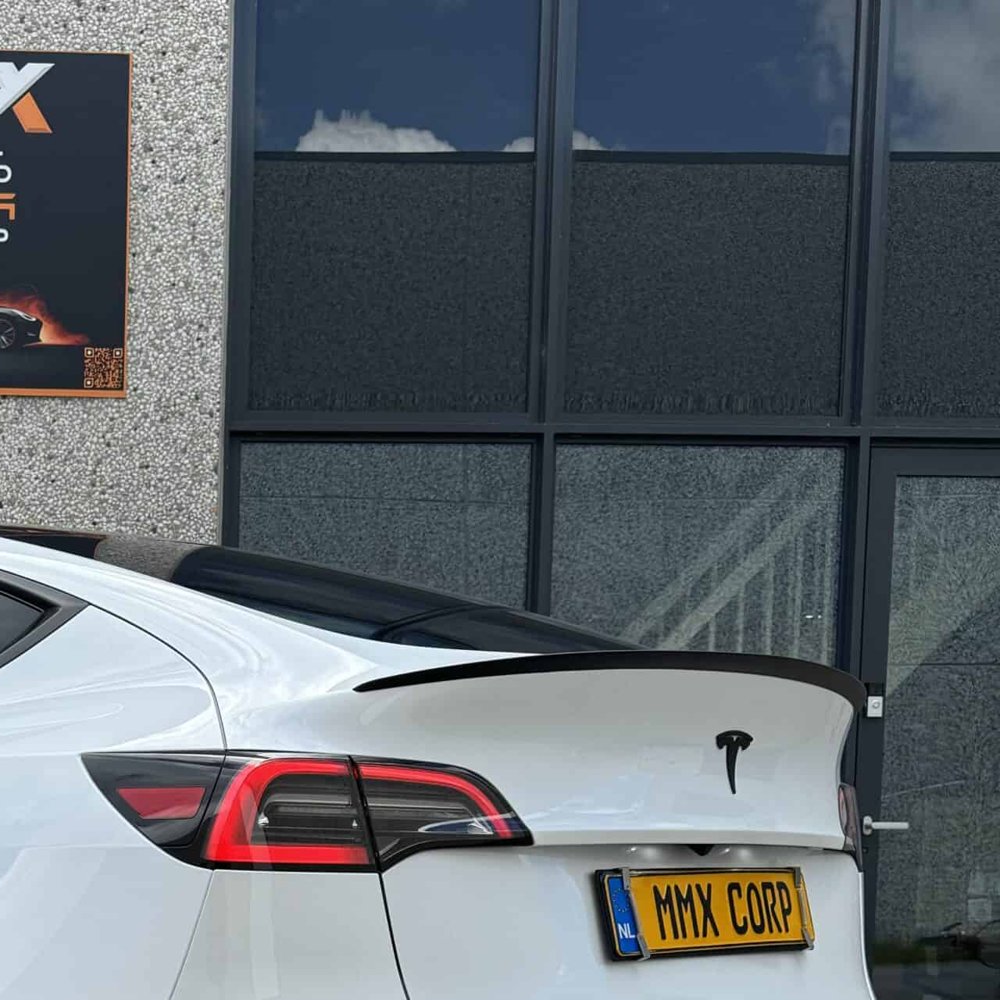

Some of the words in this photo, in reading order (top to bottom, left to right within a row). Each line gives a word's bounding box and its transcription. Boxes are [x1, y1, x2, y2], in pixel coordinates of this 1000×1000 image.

[652, 882, 720, 940] MMX
[726, 881, 793, 936] CORP
[617, 922, 636, 939] NL
